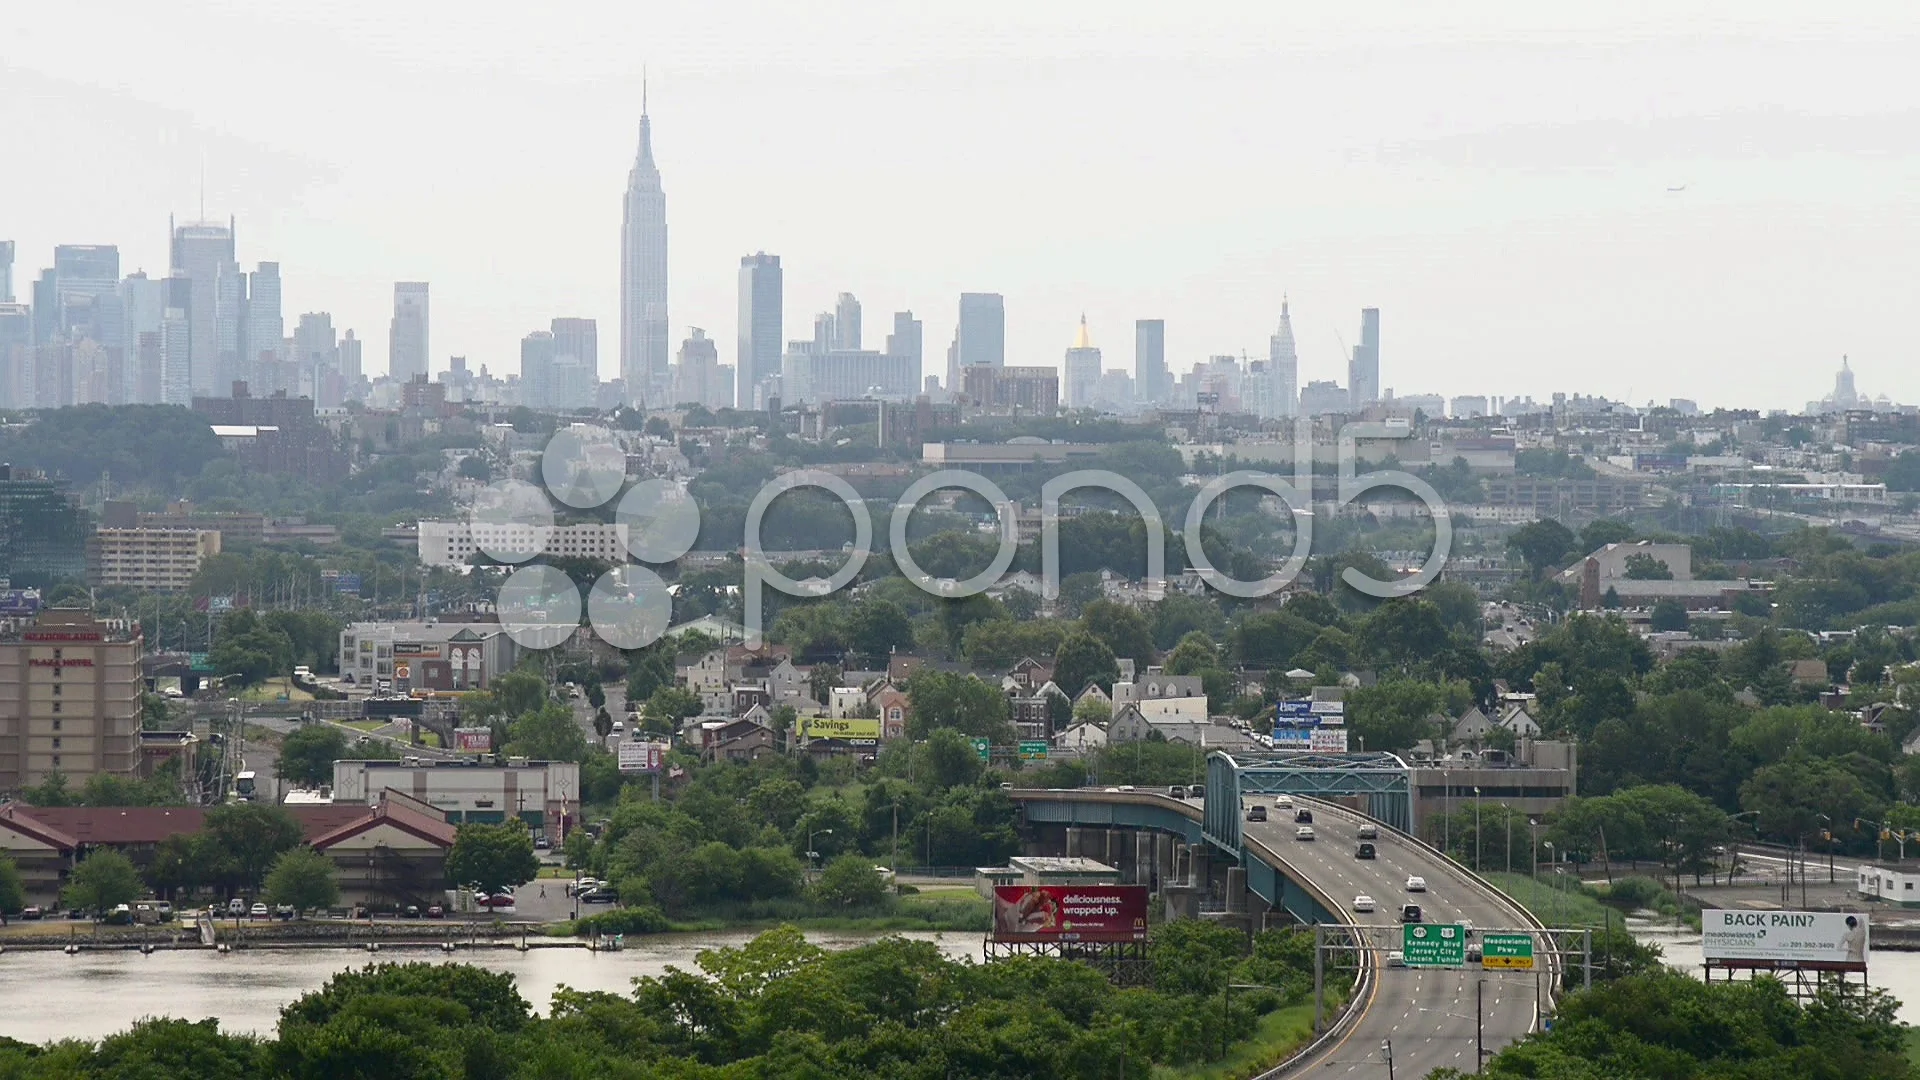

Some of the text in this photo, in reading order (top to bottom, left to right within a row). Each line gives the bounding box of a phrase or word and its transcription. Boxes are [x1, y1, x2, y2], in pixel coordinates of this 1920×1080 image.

[63, 659, 94, 667] HOTEL
[814, 719, 849, 731] Savings
[1063, 894, 1122, 904] deliciousness.
[1063, 905, 1118, 916] wrapped up.
[1724, 913, 1815, 928] BACK PAIN?
[1407, 940, 1440, 948] Kennedy
[1704, 938, 1756, 946] PHYSICIANS
[1411, 948, 1457, 956] Jersey City
